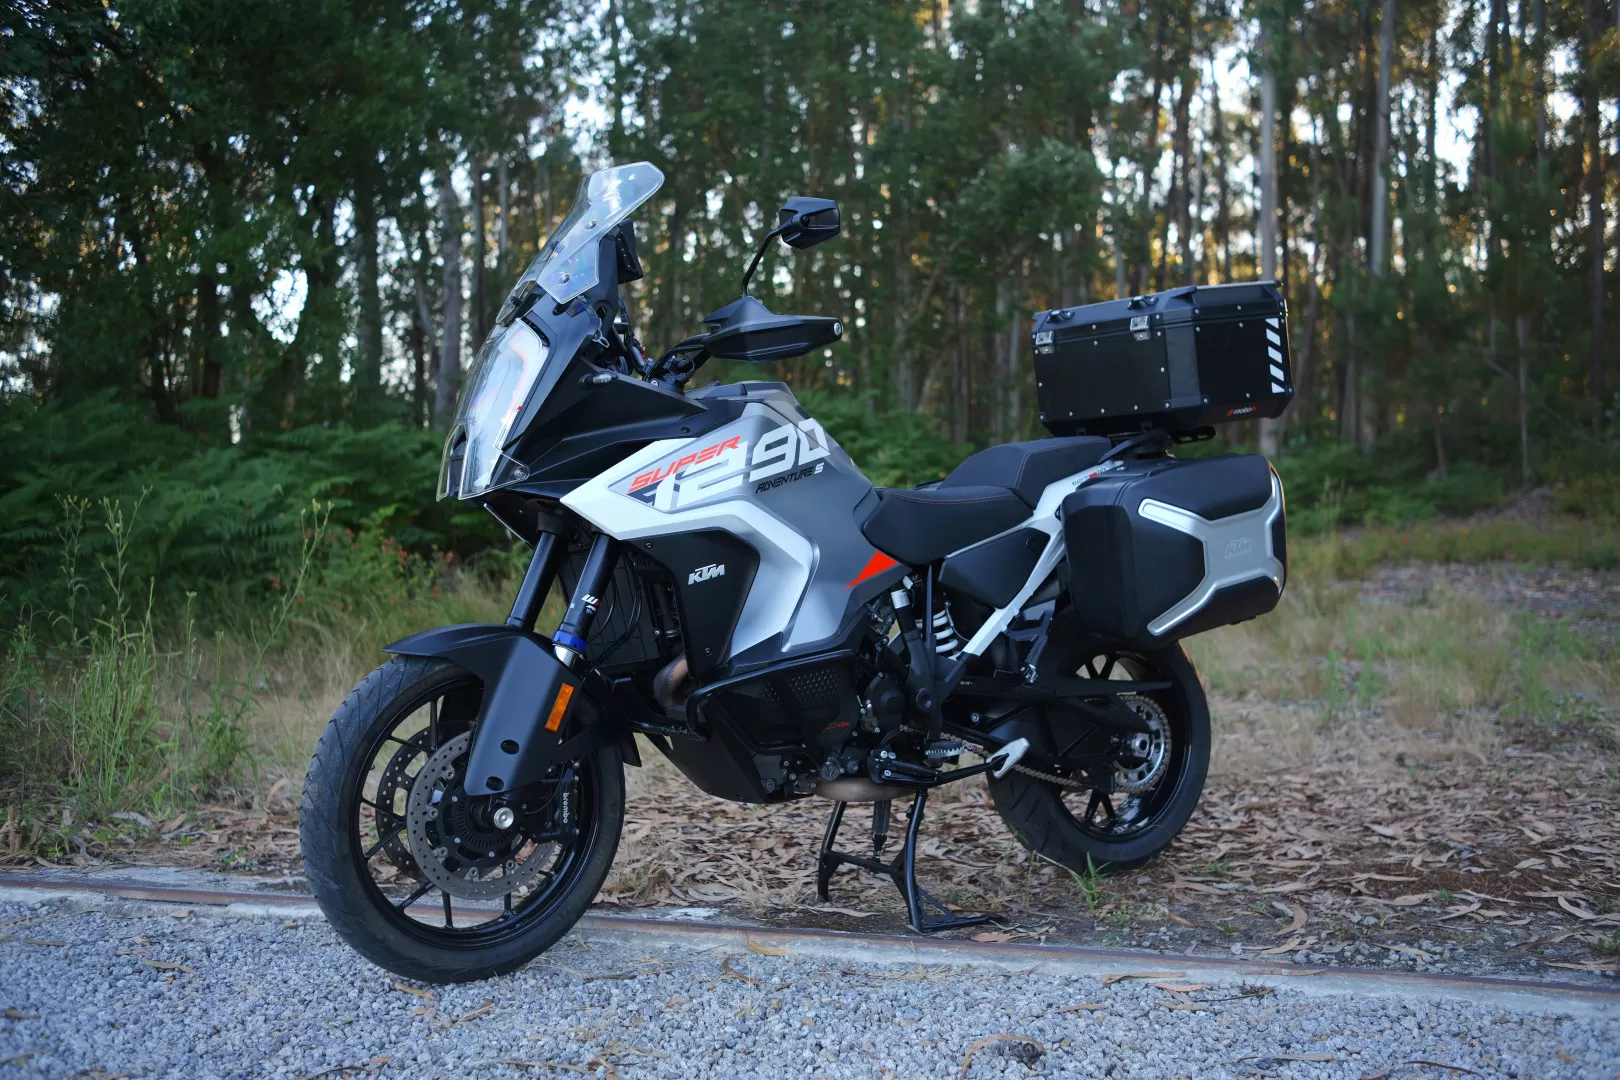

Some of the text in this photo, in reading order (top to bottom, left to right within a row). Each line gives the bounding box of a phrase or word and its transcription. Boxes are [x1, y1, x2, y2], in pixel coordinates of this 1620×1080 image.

[628, 435, 741, 493] SUPER
[645, 417, 830, 511] 1290
[755, 462, 825, 494] ADVENTURE S
[1224, 537, 1252, 561] KTM
[688, 564, 725, 586] KTM
[562, 792, 570, 824] brembo
